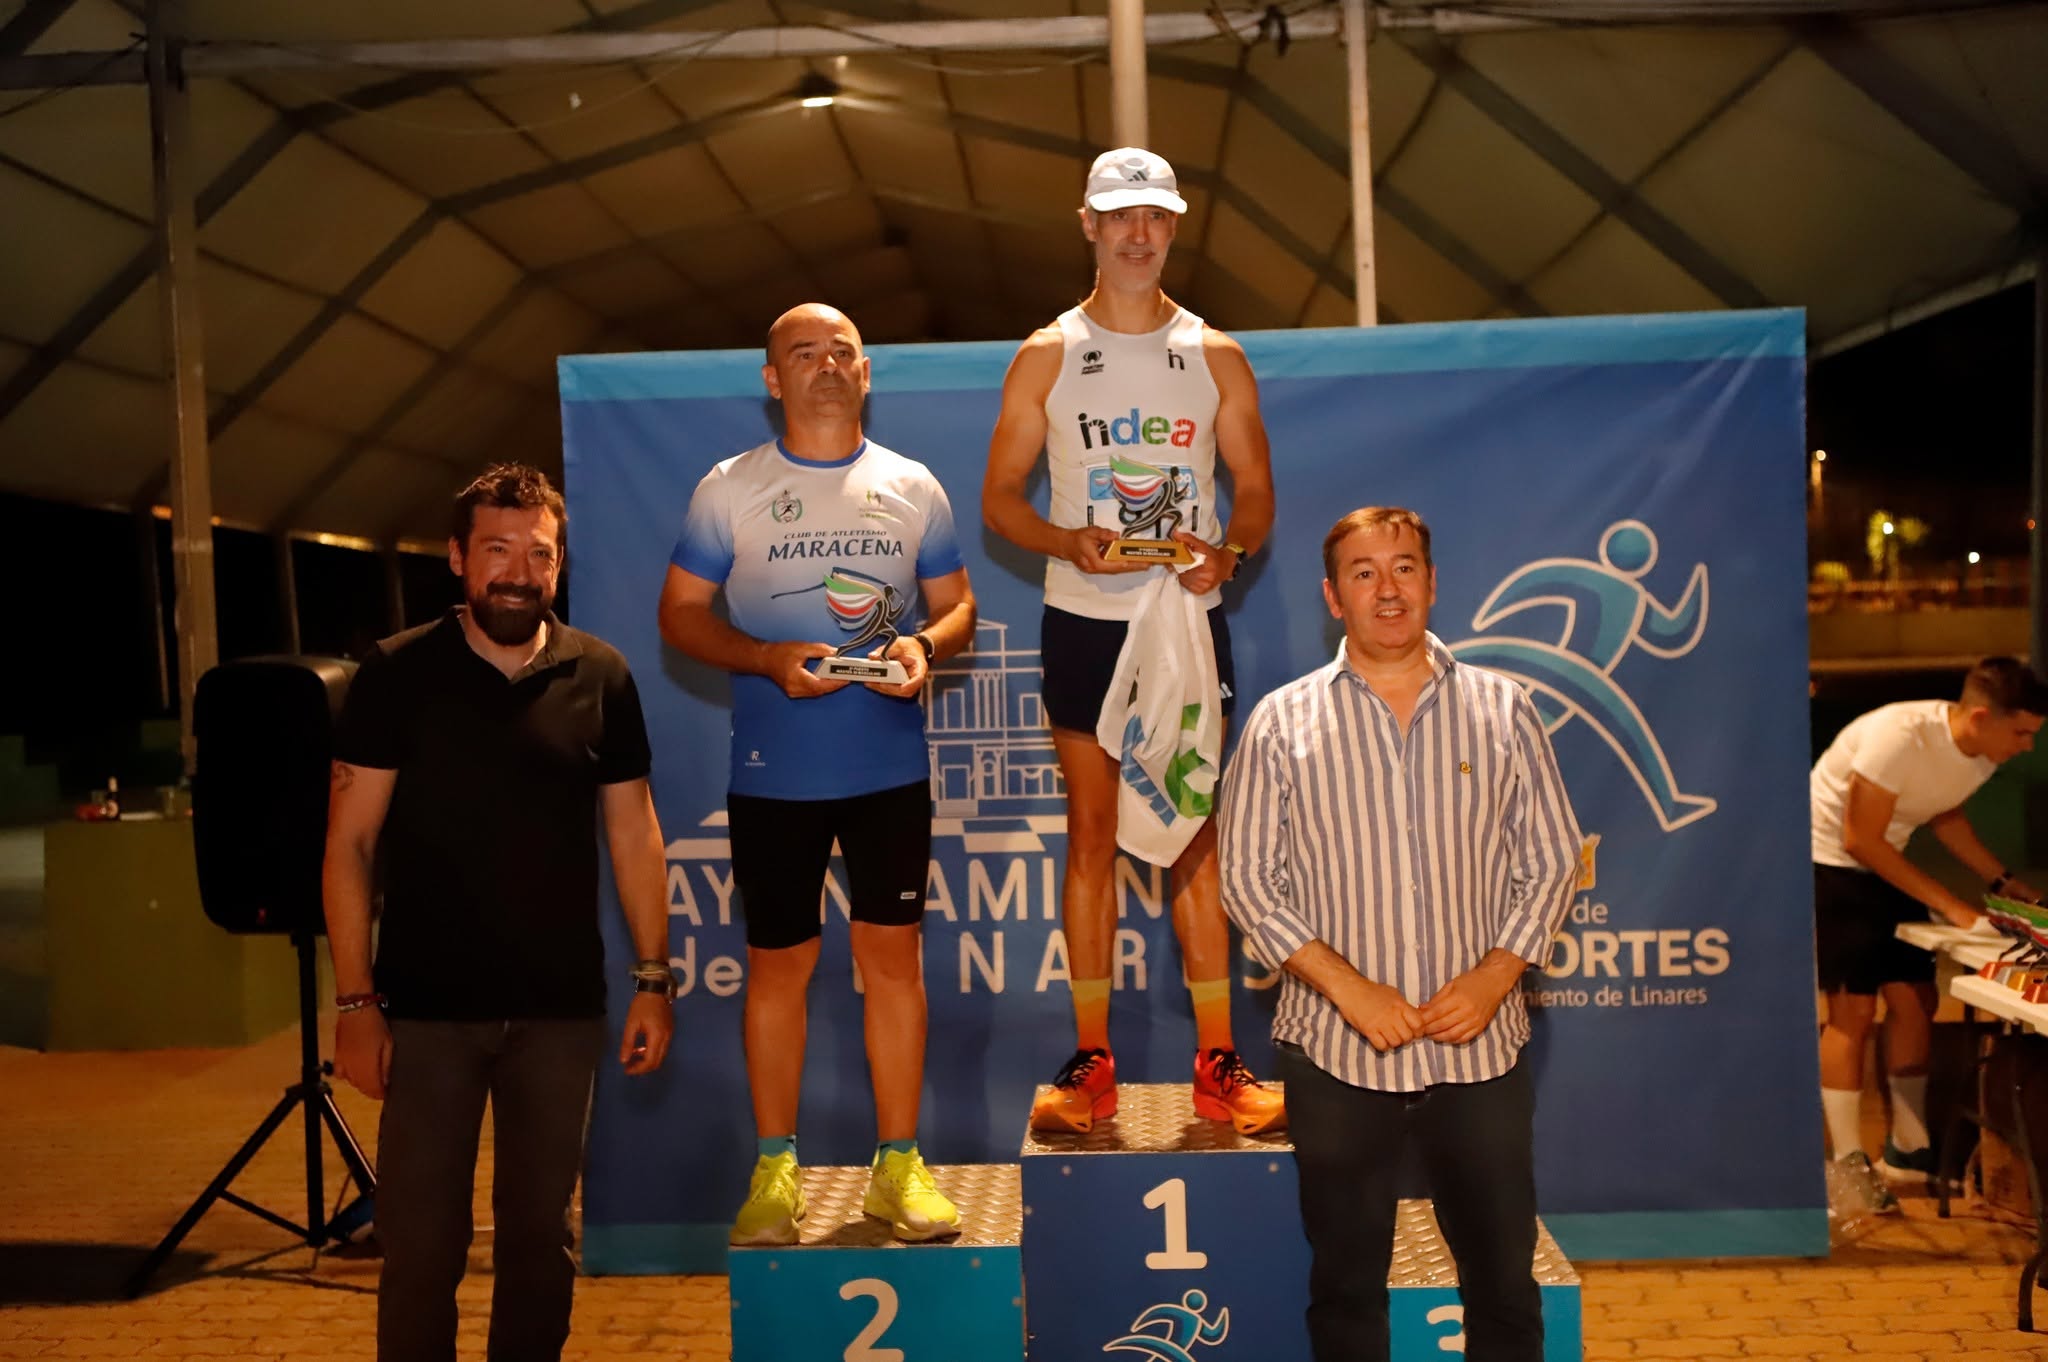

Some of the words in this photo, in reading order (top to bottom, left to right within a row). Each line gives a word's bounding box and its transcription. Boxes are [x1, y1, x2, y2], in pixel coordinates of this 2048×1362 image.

[1168, 348, 1186, 371] in
[1078, 408, 1197, 450] indea
[784, 531, 812, 540] CLUB
[830, 529, 888, 538] ATLETISMO
[768, 539, 904, 562] MARACENA
[1570, 896, 1609, 925] de
[668, 936, 744, 998] de
[1594, 984, 1624, 1007] de
[1630, 984, 1708, 1007] Linares
[1143, 1178, 1208, 1270] 1
[839, 1277, 905, 1362] 2
